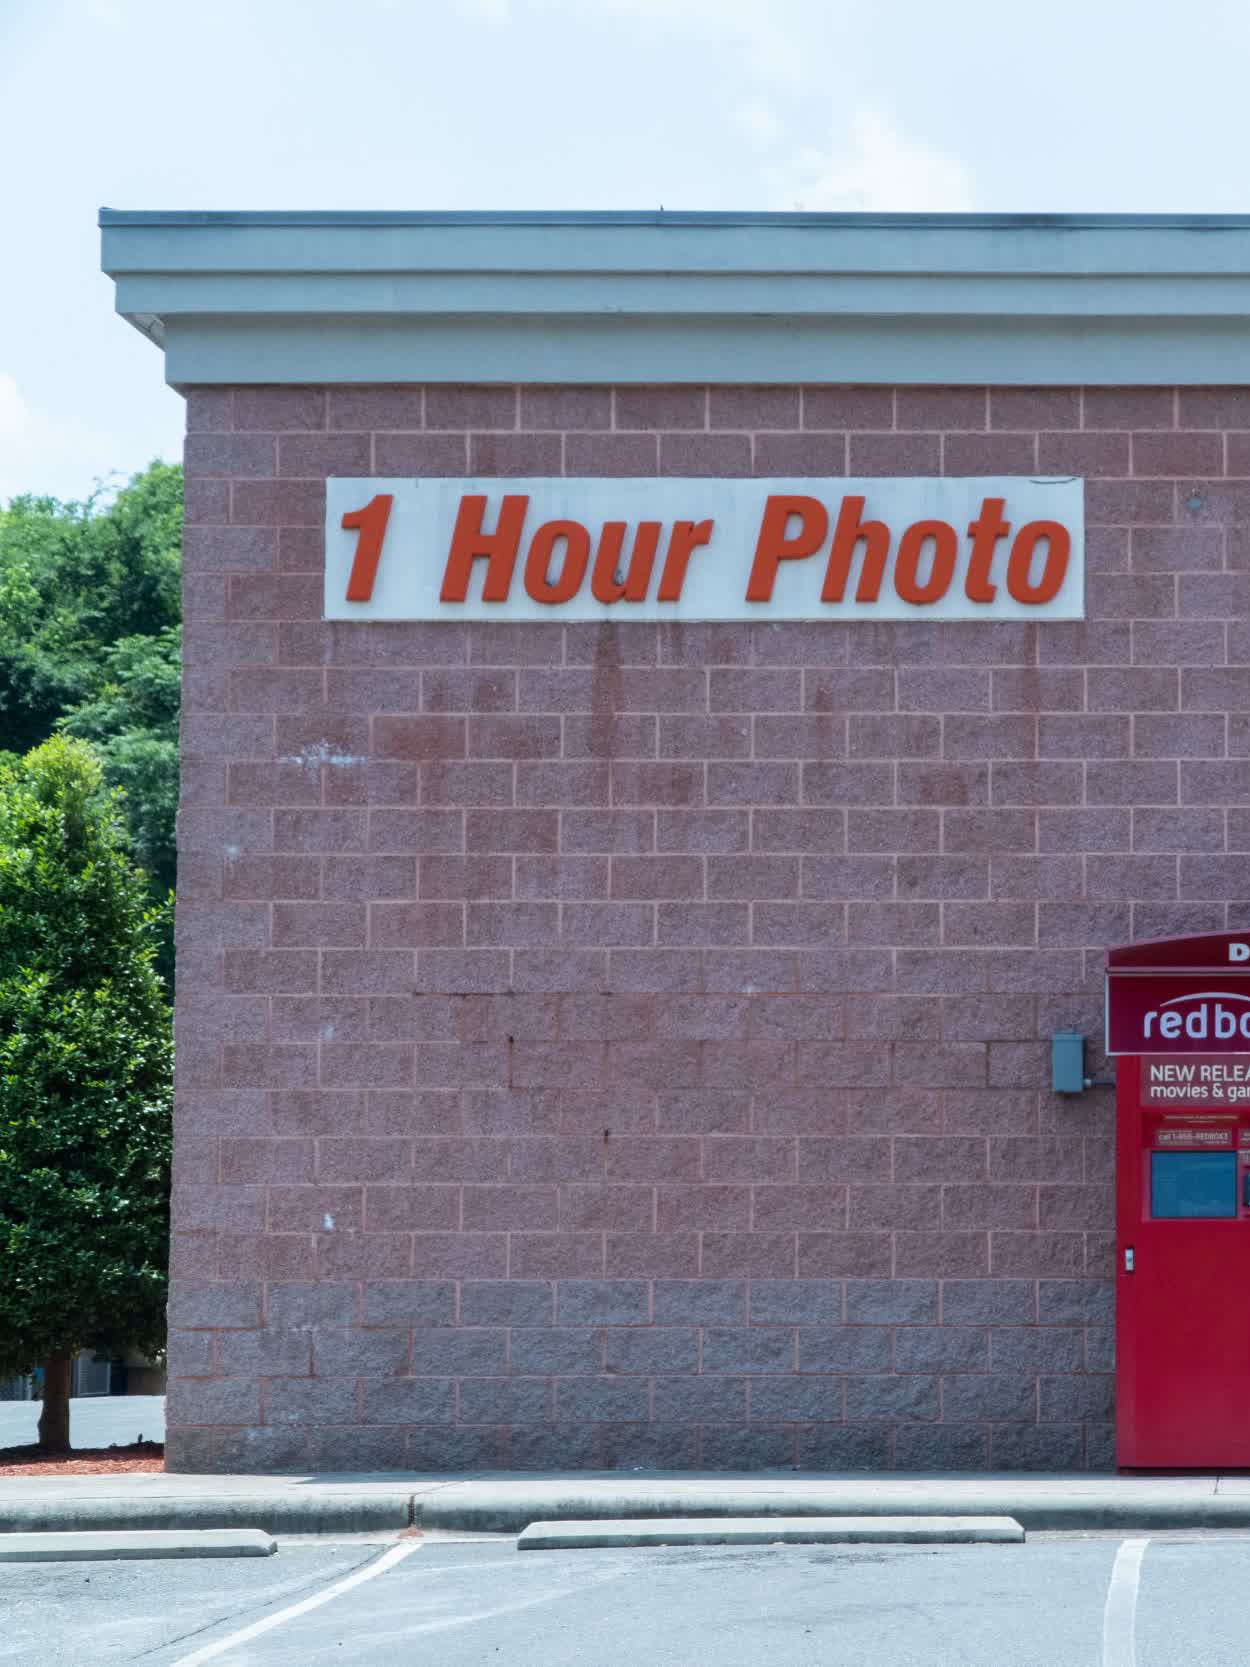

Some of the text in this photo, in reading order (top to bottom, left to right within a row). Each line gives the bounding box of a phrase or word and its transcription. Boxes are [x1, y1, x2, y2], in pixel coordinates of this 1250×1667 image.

[339, 494, 1073, 606] 1 Hour Photo
[1150, 1065, 1195, 1082] NEW
[1150, 1083, 1208, 1098] movies
[1212, 1083, 1224, 1098] &
